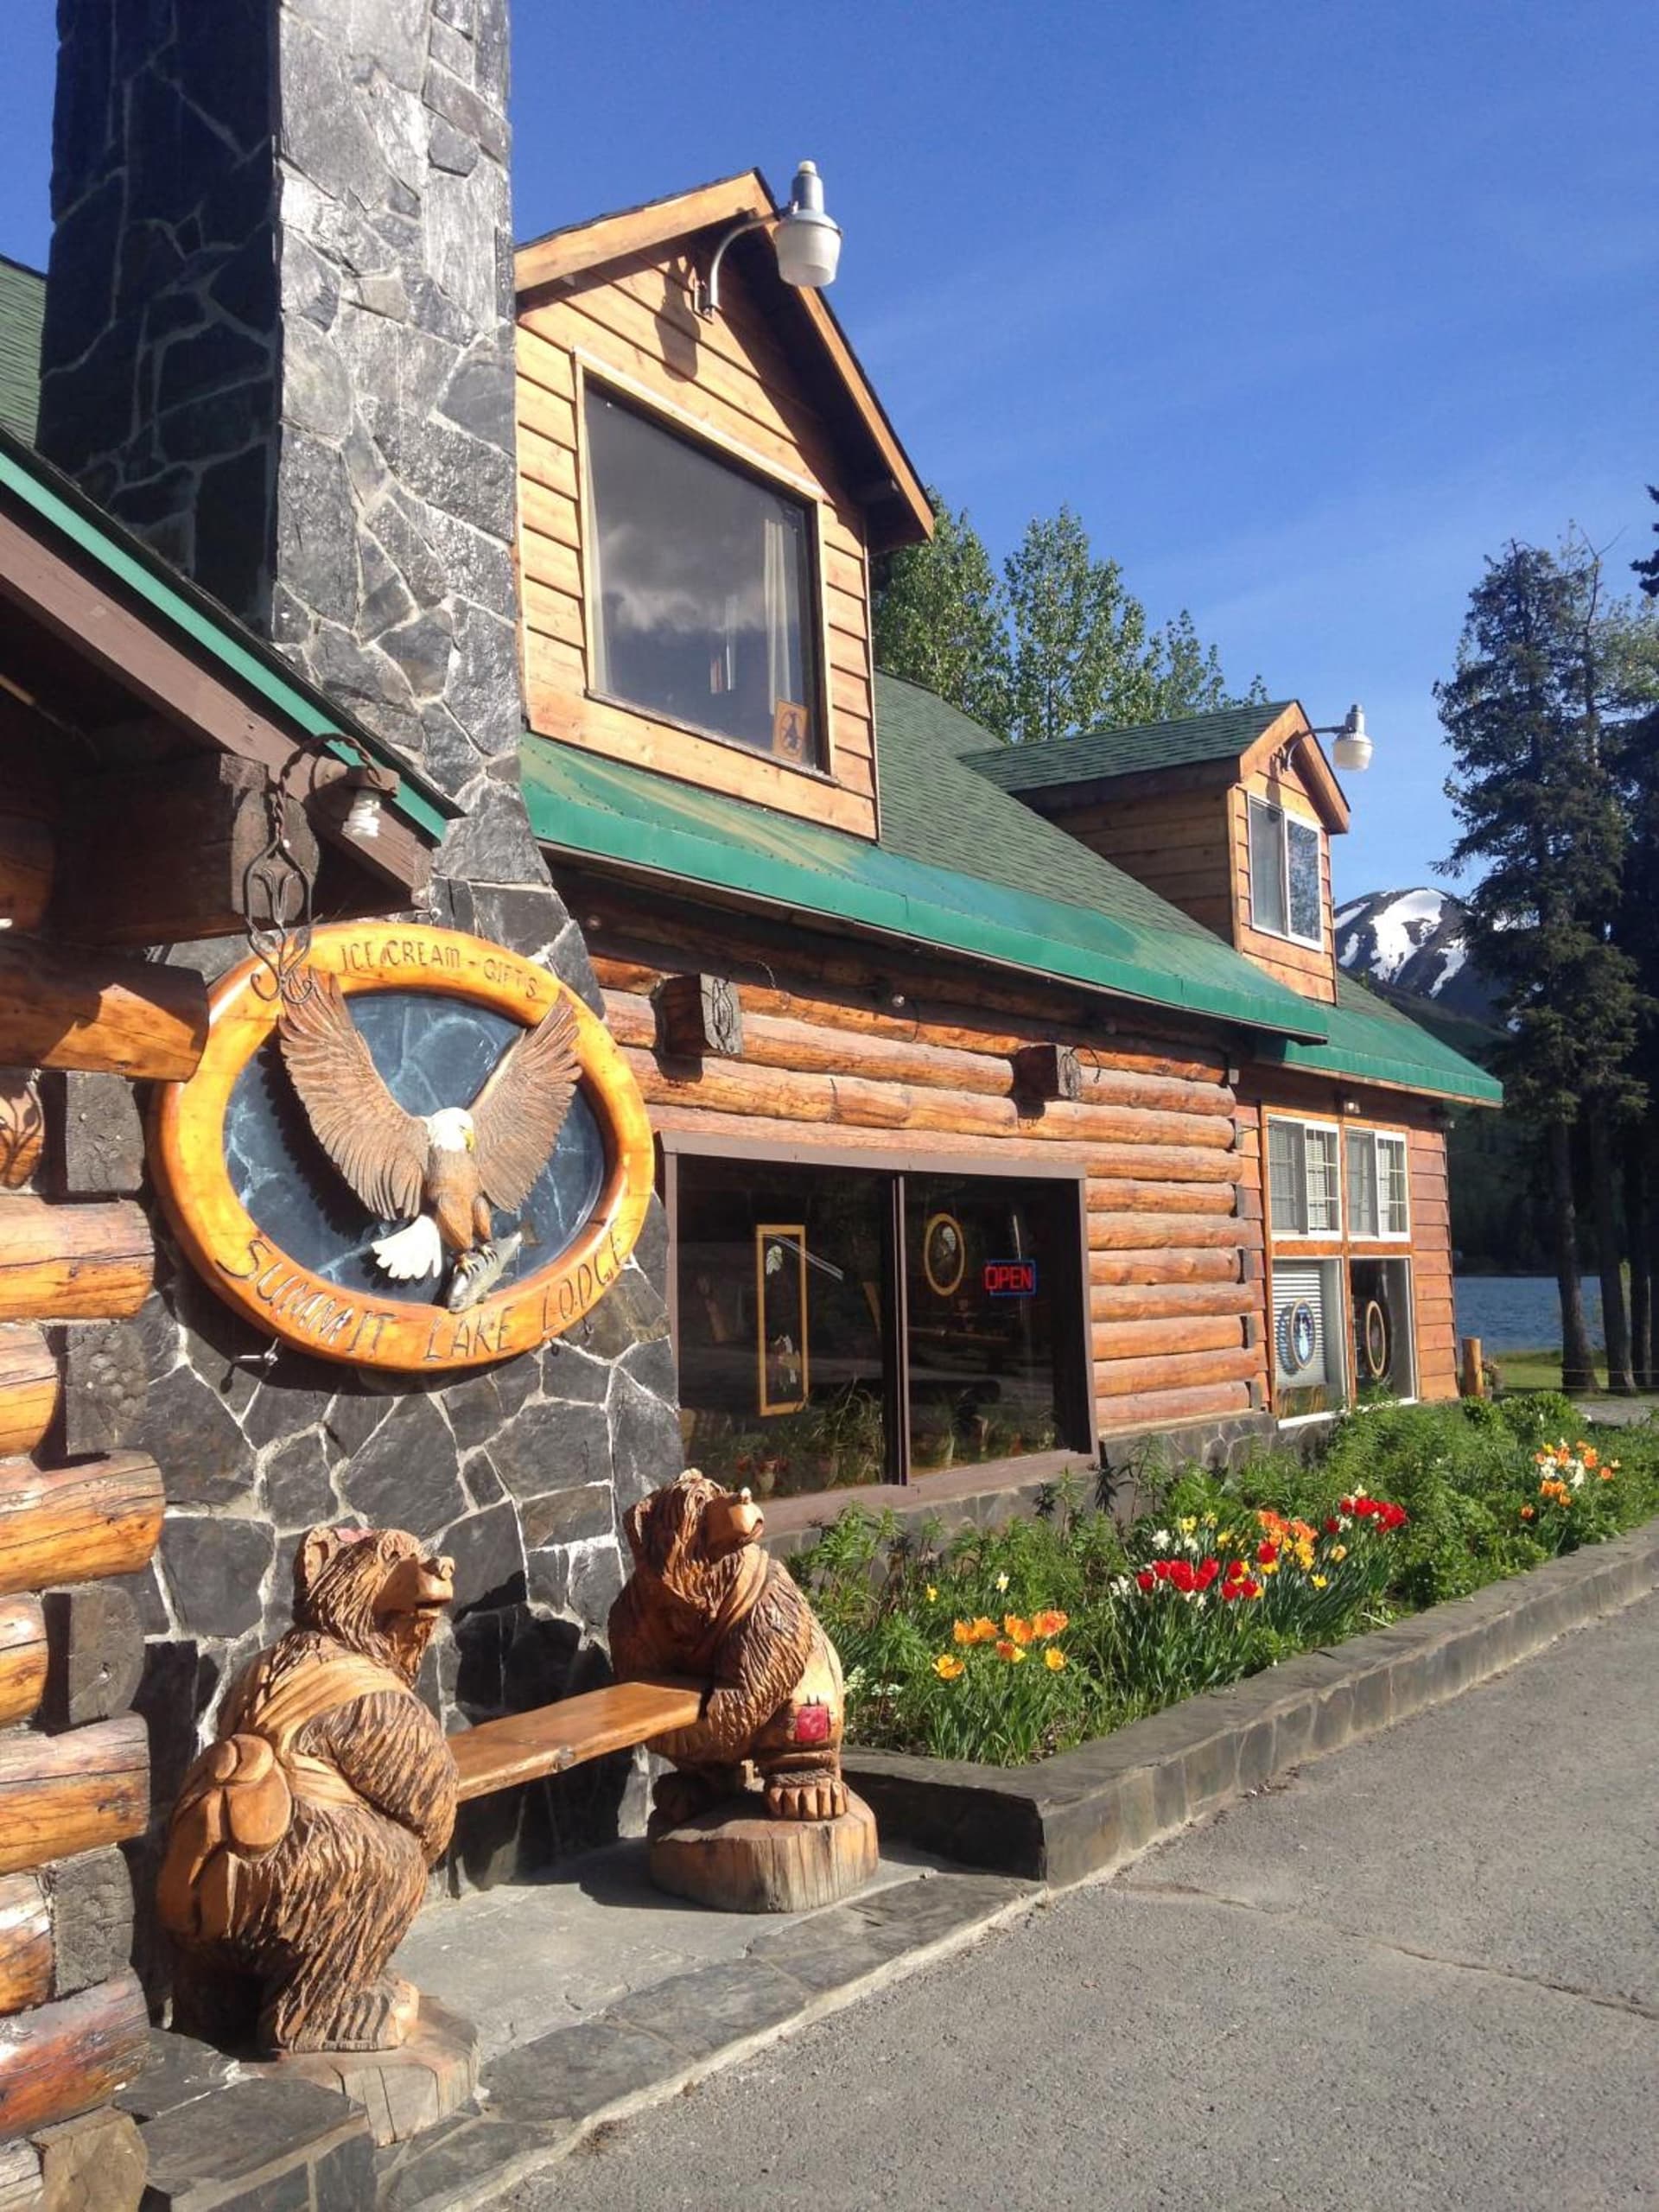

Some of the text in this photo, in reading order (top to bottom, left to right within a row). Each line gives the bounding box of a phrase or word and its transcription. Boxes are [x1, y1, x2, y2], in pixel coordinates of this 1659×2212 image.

[340, 939, 375, 972] ICE
[483, 957, 538, 999] GIFTS
[214, 1218, 631, 1362] SUMMIT LAKE LODGE
[984, 1265, 1033, 1290] OPEN
